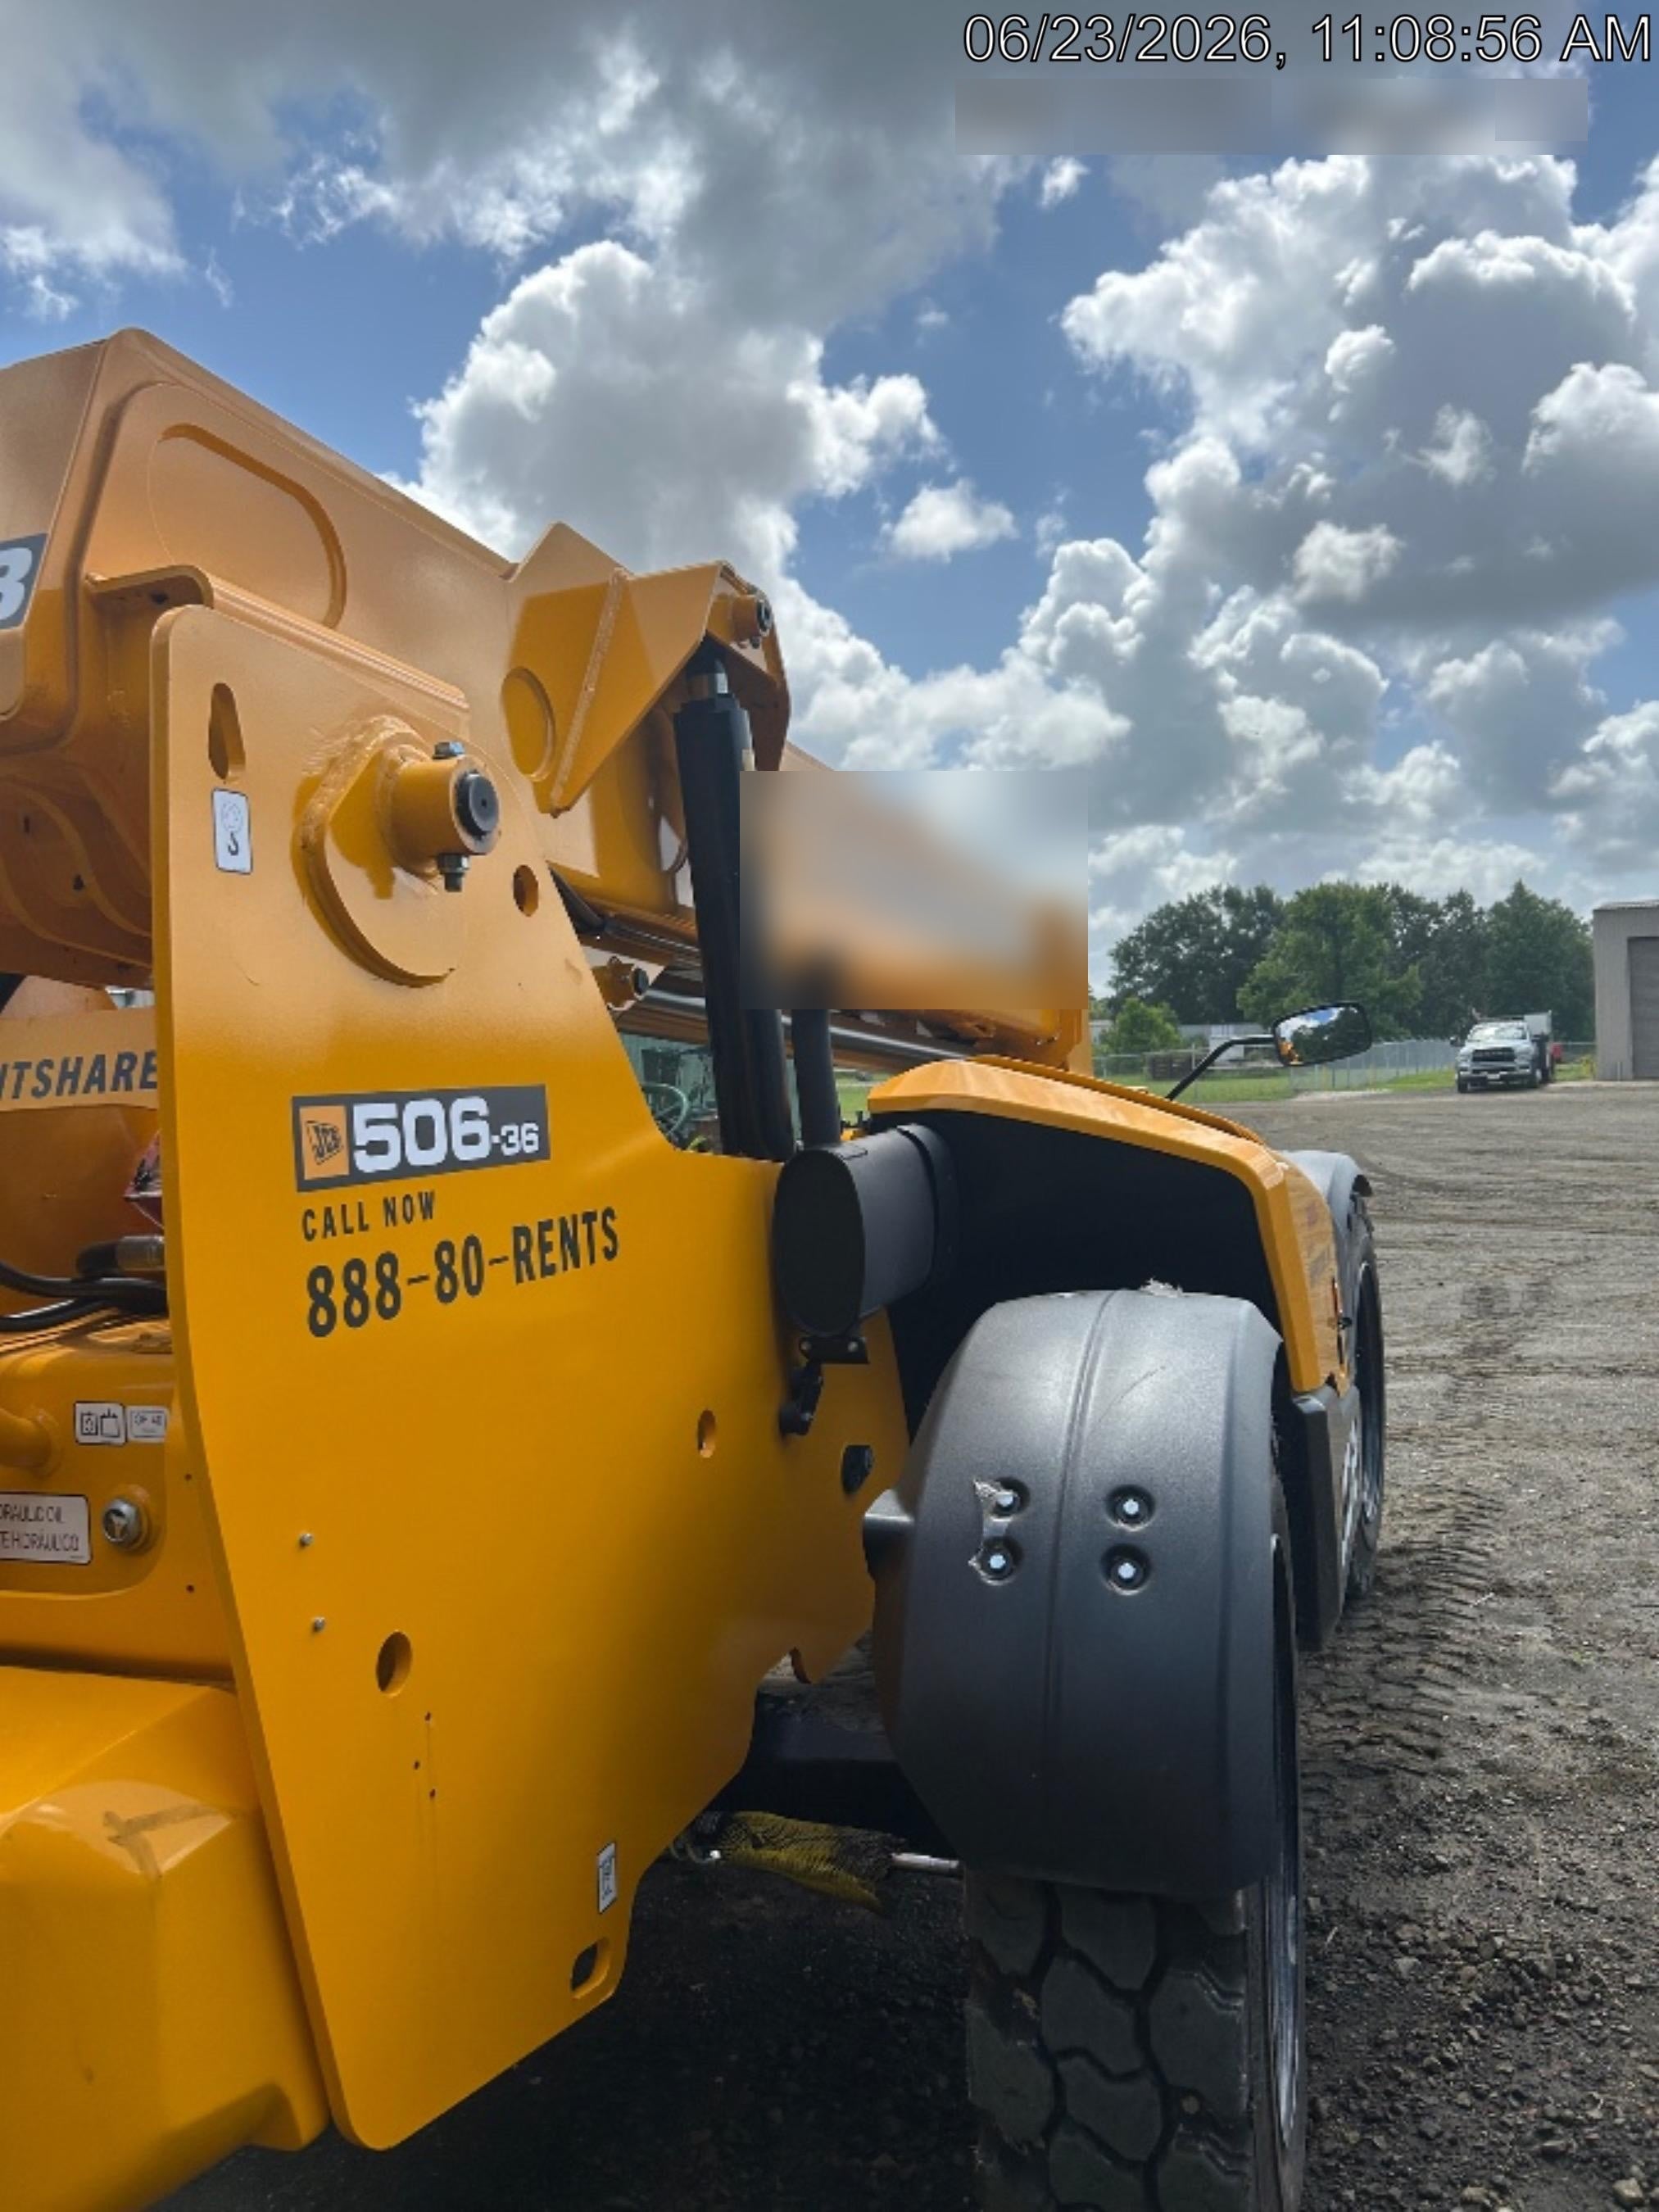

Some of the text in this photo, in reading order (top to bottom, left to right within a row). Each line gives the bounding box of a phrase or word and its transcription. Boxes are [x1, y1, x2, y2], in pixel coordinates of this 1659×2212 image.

[302, 1190, 435, 1241] CALL NOW
[306, 1207, 619, 1338] 888-80-RENTS
